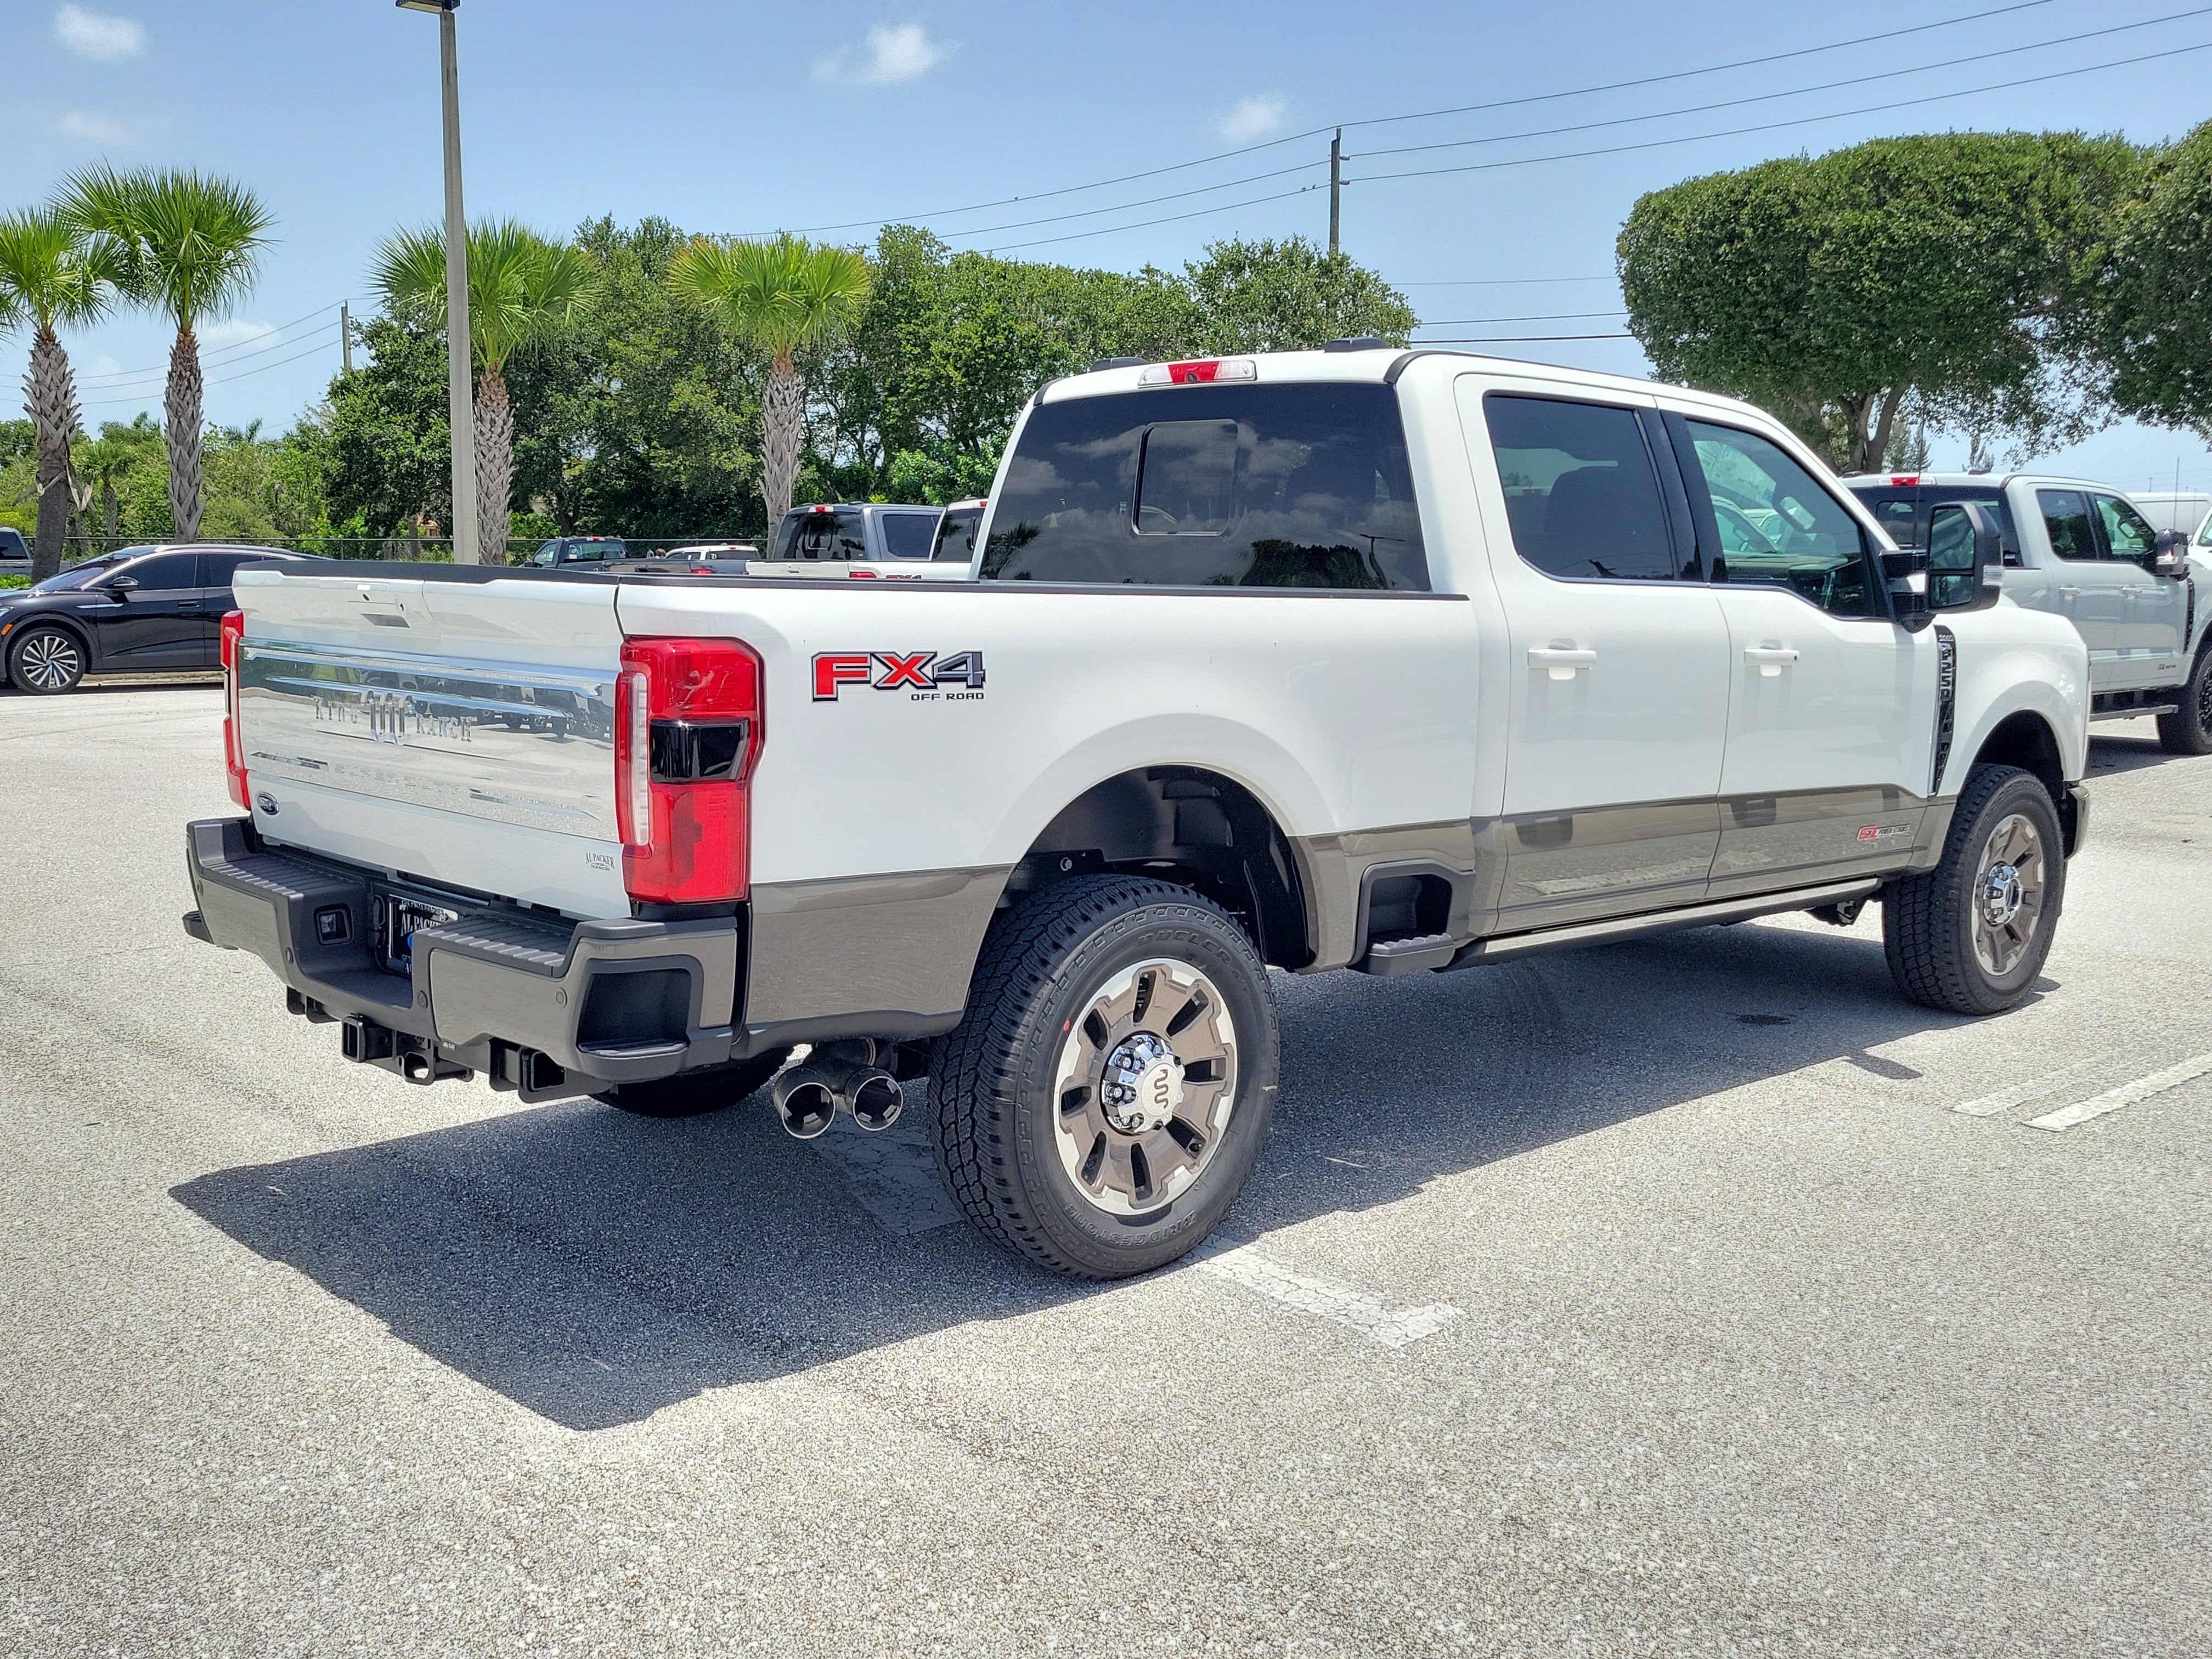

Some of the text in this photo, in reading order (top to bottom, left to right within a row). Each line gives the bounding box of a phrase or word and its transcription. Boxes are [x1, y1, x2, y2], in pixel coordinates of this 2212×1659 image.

[812, 651, 985, 703] FX4
[585, 852, 592, 864] AL
[593, 853, 615, 870] PACKER
[400, 912, 413, 936] AL
[1065, 1204, 1197, 1246] BRIDGESTONE
